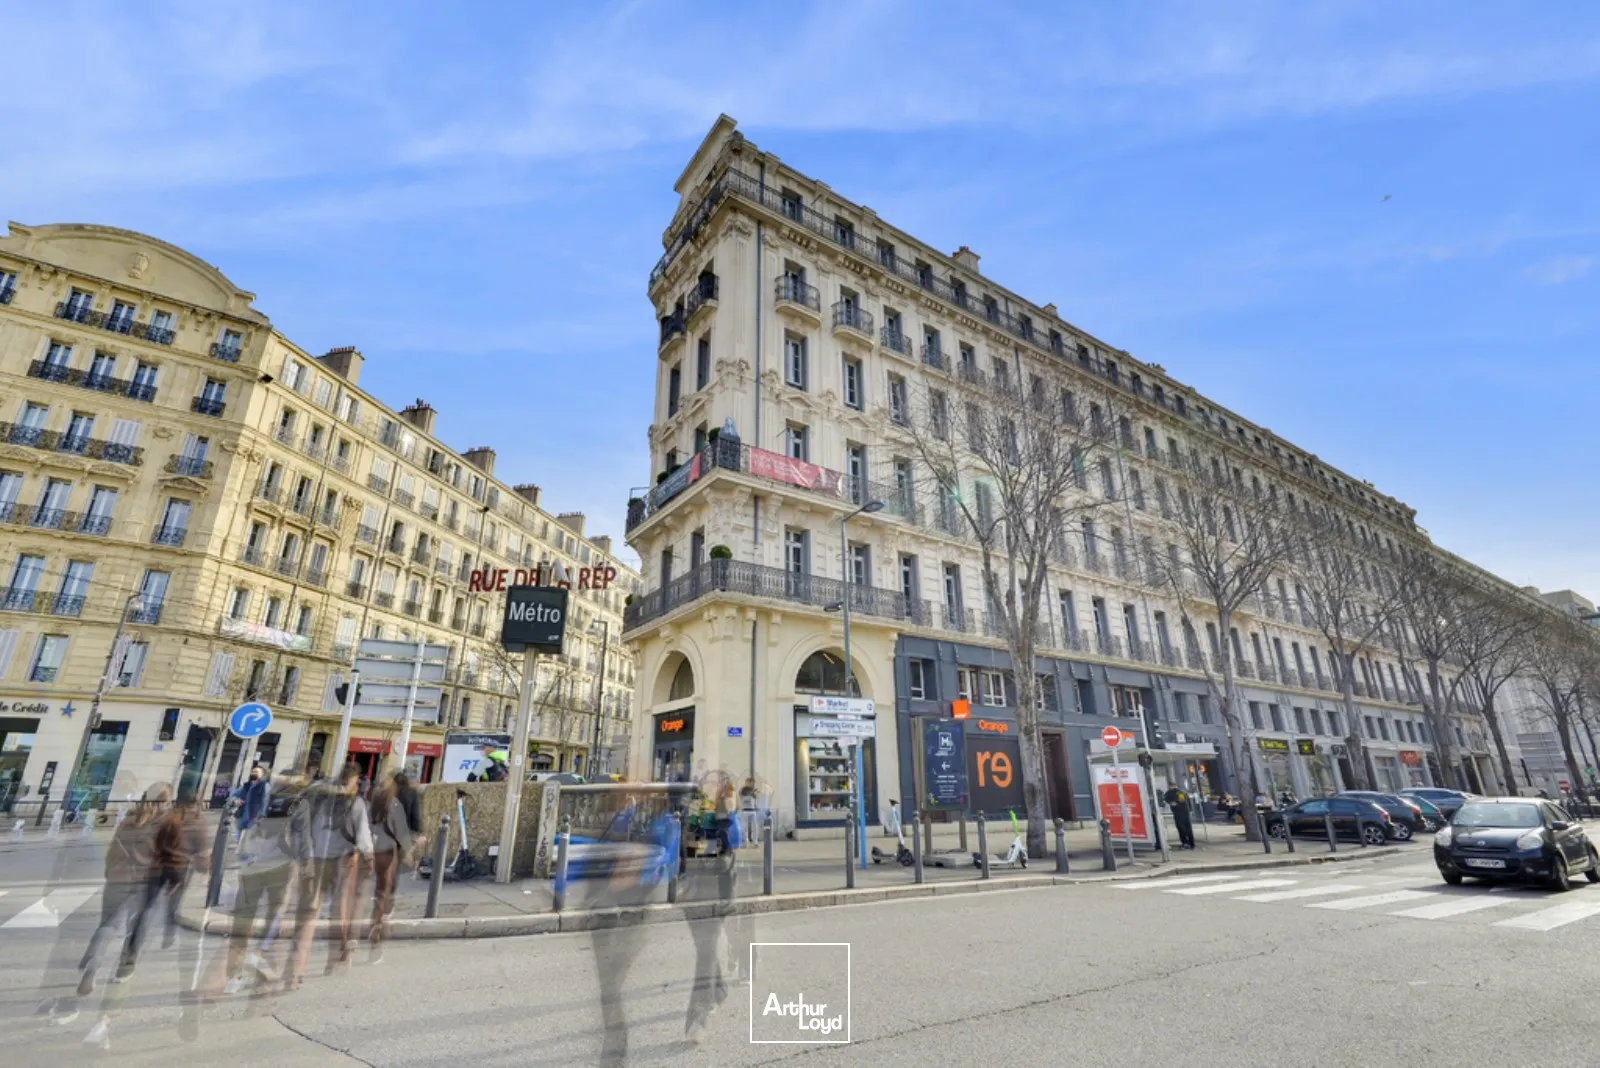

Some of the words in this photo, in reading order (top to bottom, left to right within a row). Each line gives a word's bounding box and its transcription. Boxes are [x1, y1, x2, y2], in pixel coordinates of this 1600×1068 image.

[468, 569, 509, 592] RUE
[508, 601, 561, 624] Métro
[12, 702, 49, 713] Crédit
[661, 719, 684, 732] Orange
[978, 719, 1008, 734] Orange
